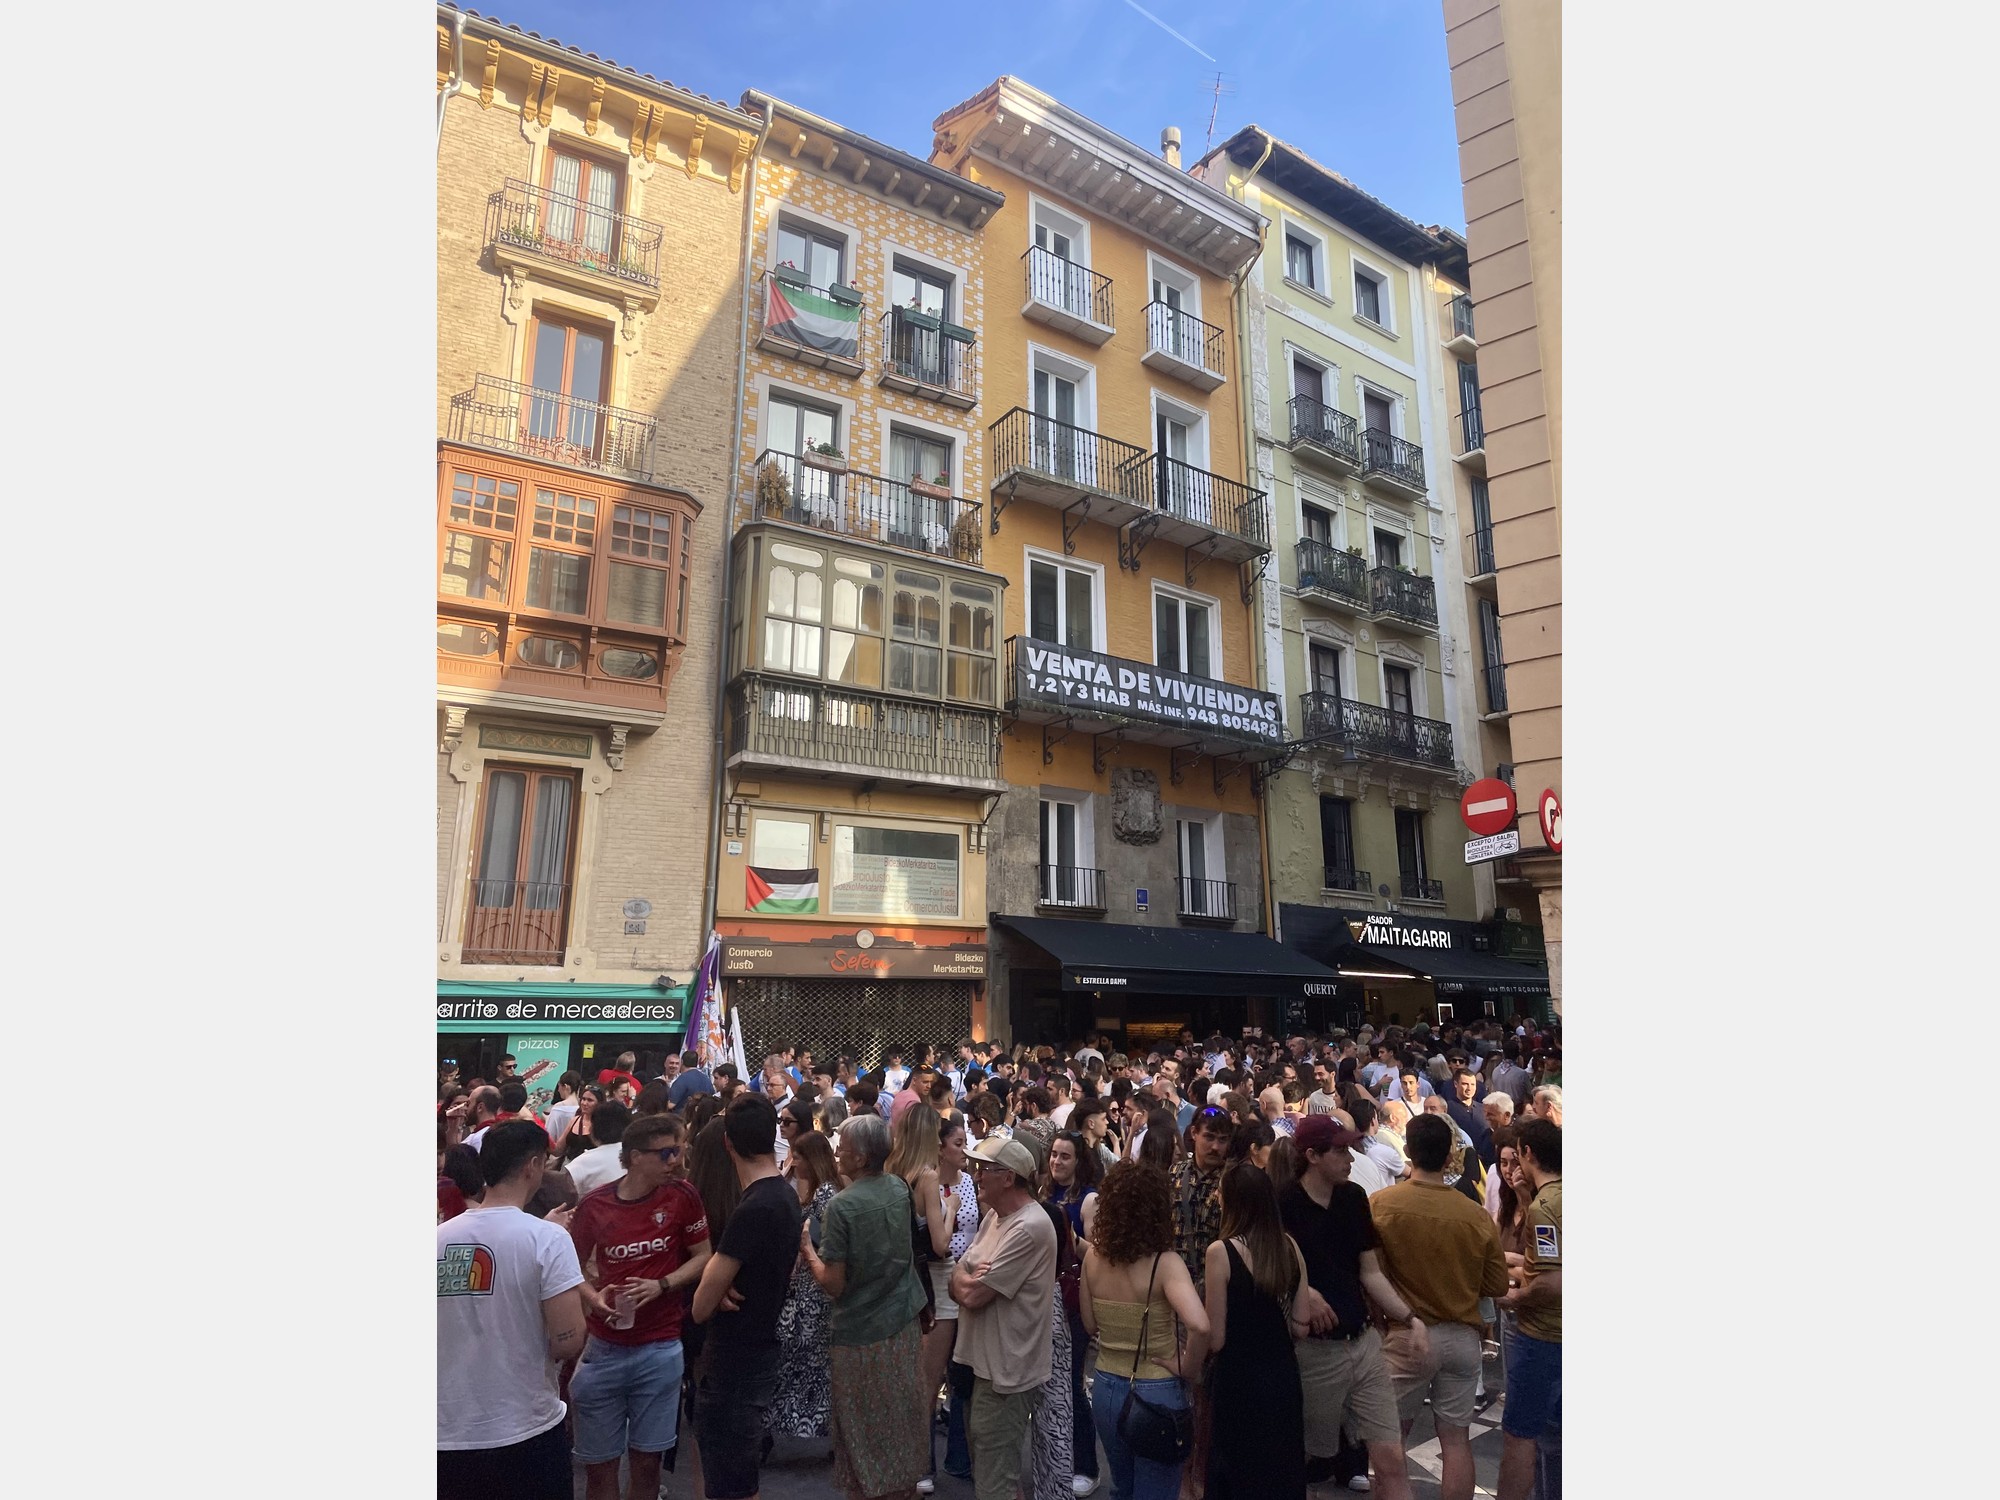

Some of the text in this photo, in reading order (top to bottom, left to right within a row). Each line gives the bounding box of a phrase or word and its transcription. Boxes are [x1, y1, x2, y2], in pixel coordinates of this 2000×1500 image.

[1026, 646, 1278, 721] VENTA DE VIVIENDAS
[1026, 673, 1278, 738] 1,2 Y 3 HAB MÁS INF. 948 805488
[1467, 838, 1492, 849] EXCEPTO
[1496, 832, 1515, 841] SALBU
[1466, 843, 1494, 855] BICICLETAS
[1366, 915, 1393, 925] ASADOR
[1367, 925, 1452, 949] MAITAGARRI
[728, 947, 773, 958] Comercio
[954, 952, 984, 963] Bidezko
[727, 959, 754, 970] Justo
[830, 949, 896, 973] Setem
[933, 964, 984, 975] Merkataritza
[1082, 977, 1109, 985] ESTRELLA
[1303, 982, 1337, 997] QUERTY
[506, 1000, 538, 1019] de
[544, 1001, 676, 1019] mercaderes
[517, 1036, 560, 1052] pizzas
[448, 1248, 473, 1261] THE
[437, 1279, 468, 1292] FACE
